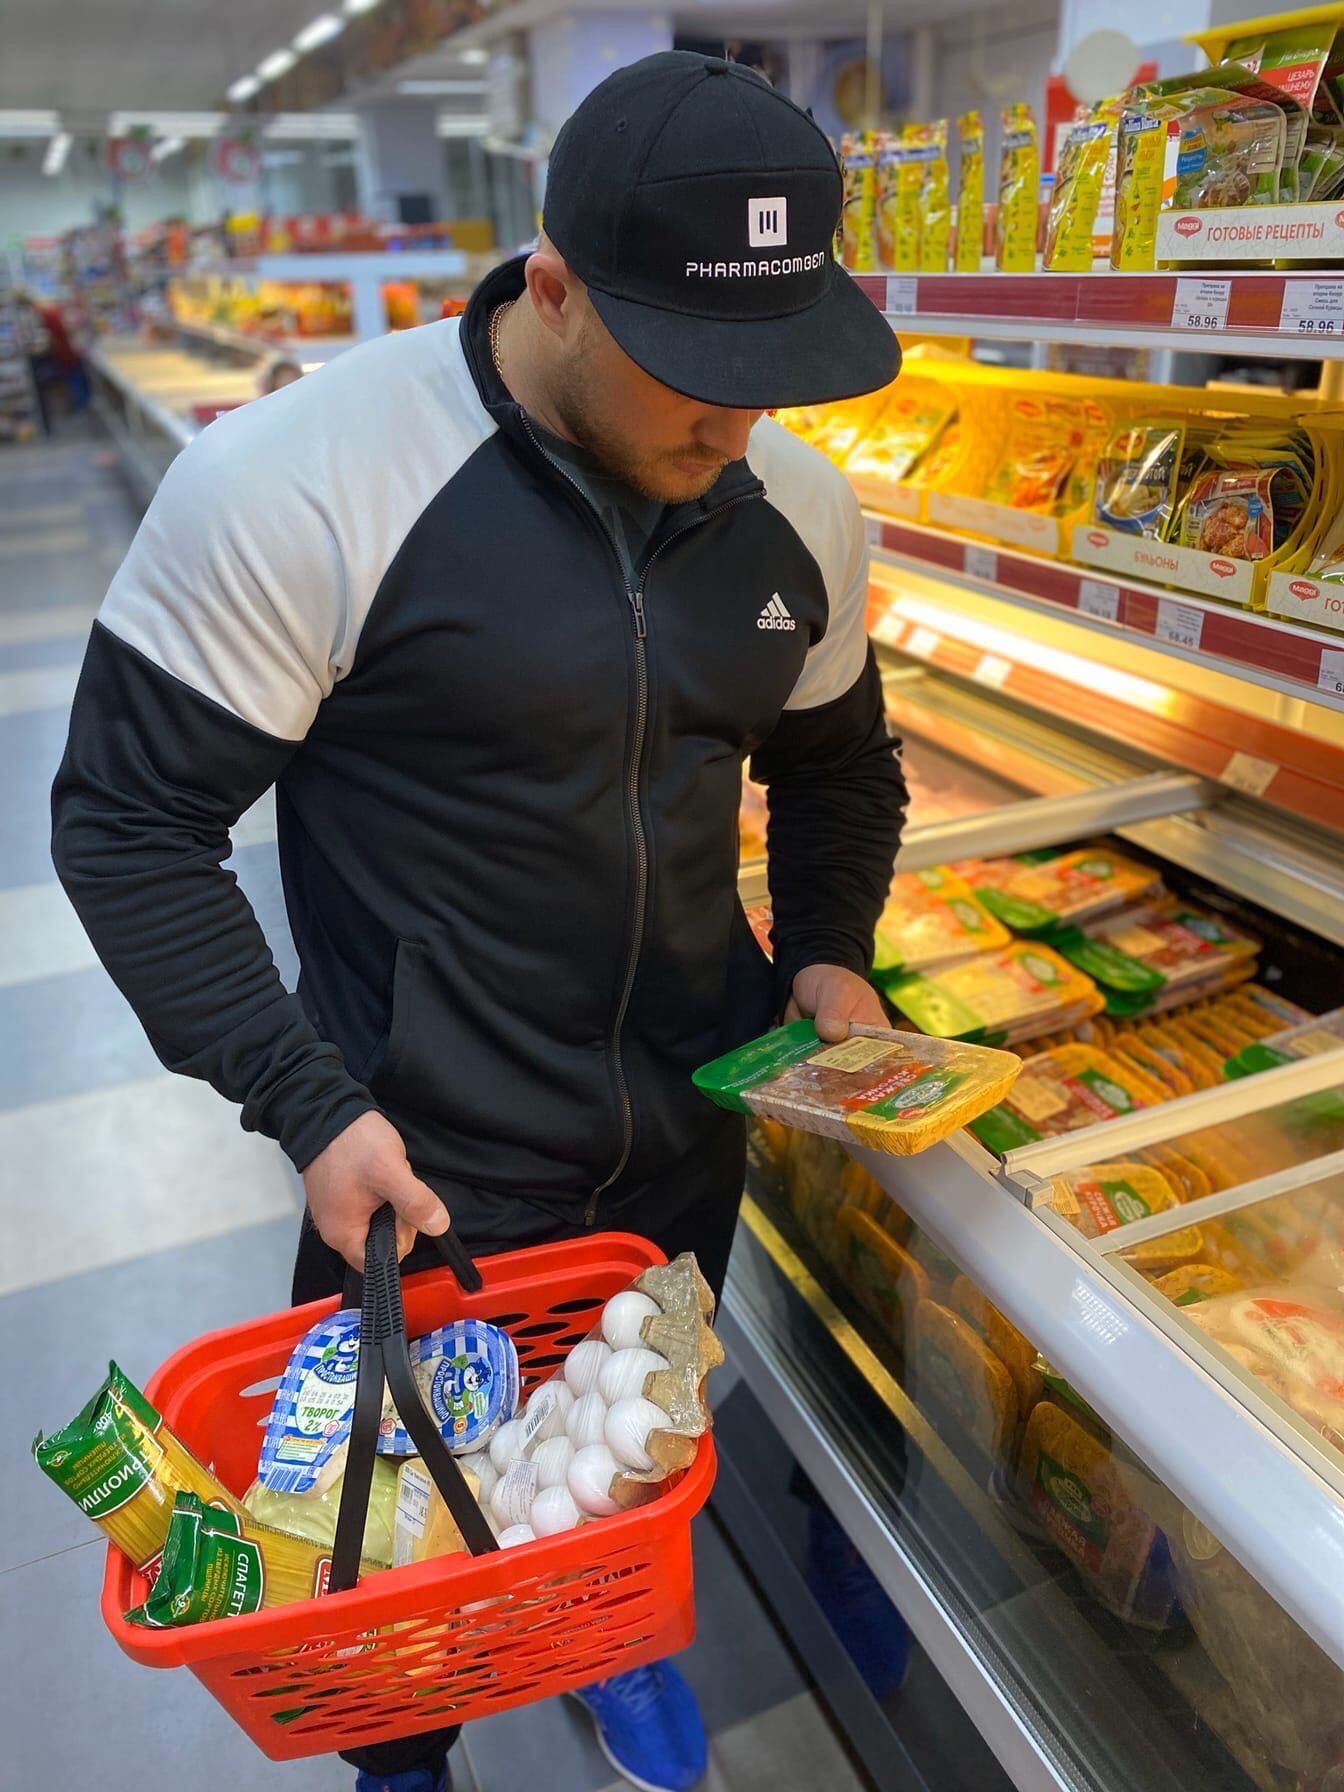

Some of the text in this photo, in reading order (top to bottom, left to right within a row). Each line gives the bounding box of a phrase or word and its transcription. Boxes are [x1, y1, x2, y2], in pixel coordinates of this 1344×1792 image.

[1207, 222, 1325, 242] ГОТОВЫЕ РЕЦЕПТЫ
[685, 251, 825, 278] PHARMACOMGEN
[1187, 315, 1218, 329] 58.96
[1298, 320, 1335, 333] 58.96
[1134, 551, 1178, 571] БУЛЬОНЫ
[757, 616, 796, 631] adidas
[317, 1366, 358, 1384] ПРОСТОКВАШИ
[302, 1406, 340, 1419] ТВОРОГ
[304, 1419, 322, 1432] 2%
[227, 1552, 249, 1617] СПАГЕТТ
